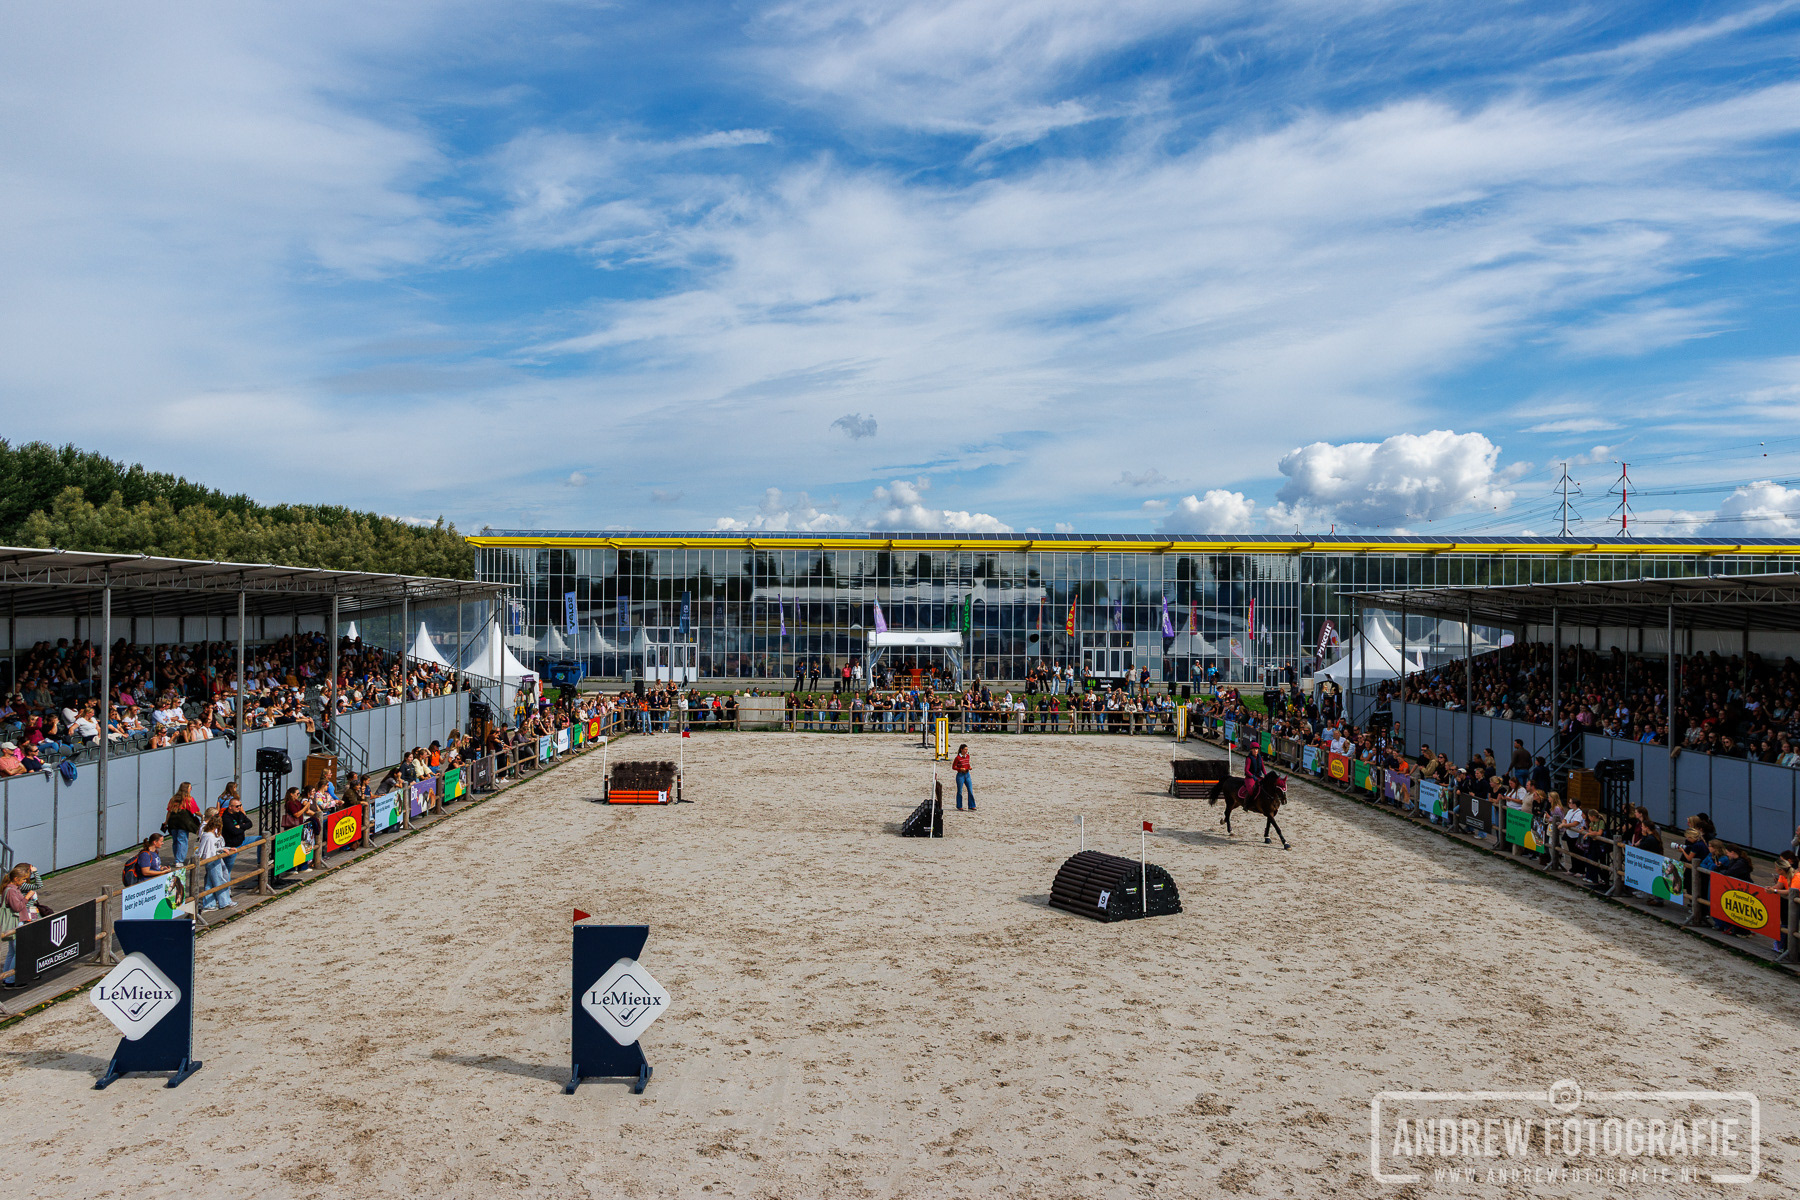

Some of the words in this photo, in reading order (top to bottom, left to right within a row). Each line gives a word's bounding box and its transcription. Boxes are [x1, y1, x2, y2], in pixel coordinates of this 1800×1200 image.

[335, 822, 354, 839] HAVENS
[1644, 857, 1660, 867] paarden
[125, 892, 136, 902] Alles
[136, 889, 146, 898] over
[146, 883, 163, 896] paarden
[1733, 892, 1750, 903] Powered
[1750, 897, 1754, 905] by
[124, 902, 133, 911] leer
[1101, 896, 1106, 904] 9
[1725, 898, 1763, 922] HAVENS
[38, 954, 54, 969] MAYA
[54, 946, 78, 964] DELOREZ
[99, 986, 173, 1000] LeMieux
[591, 991, 661, 1005] LeMieux
